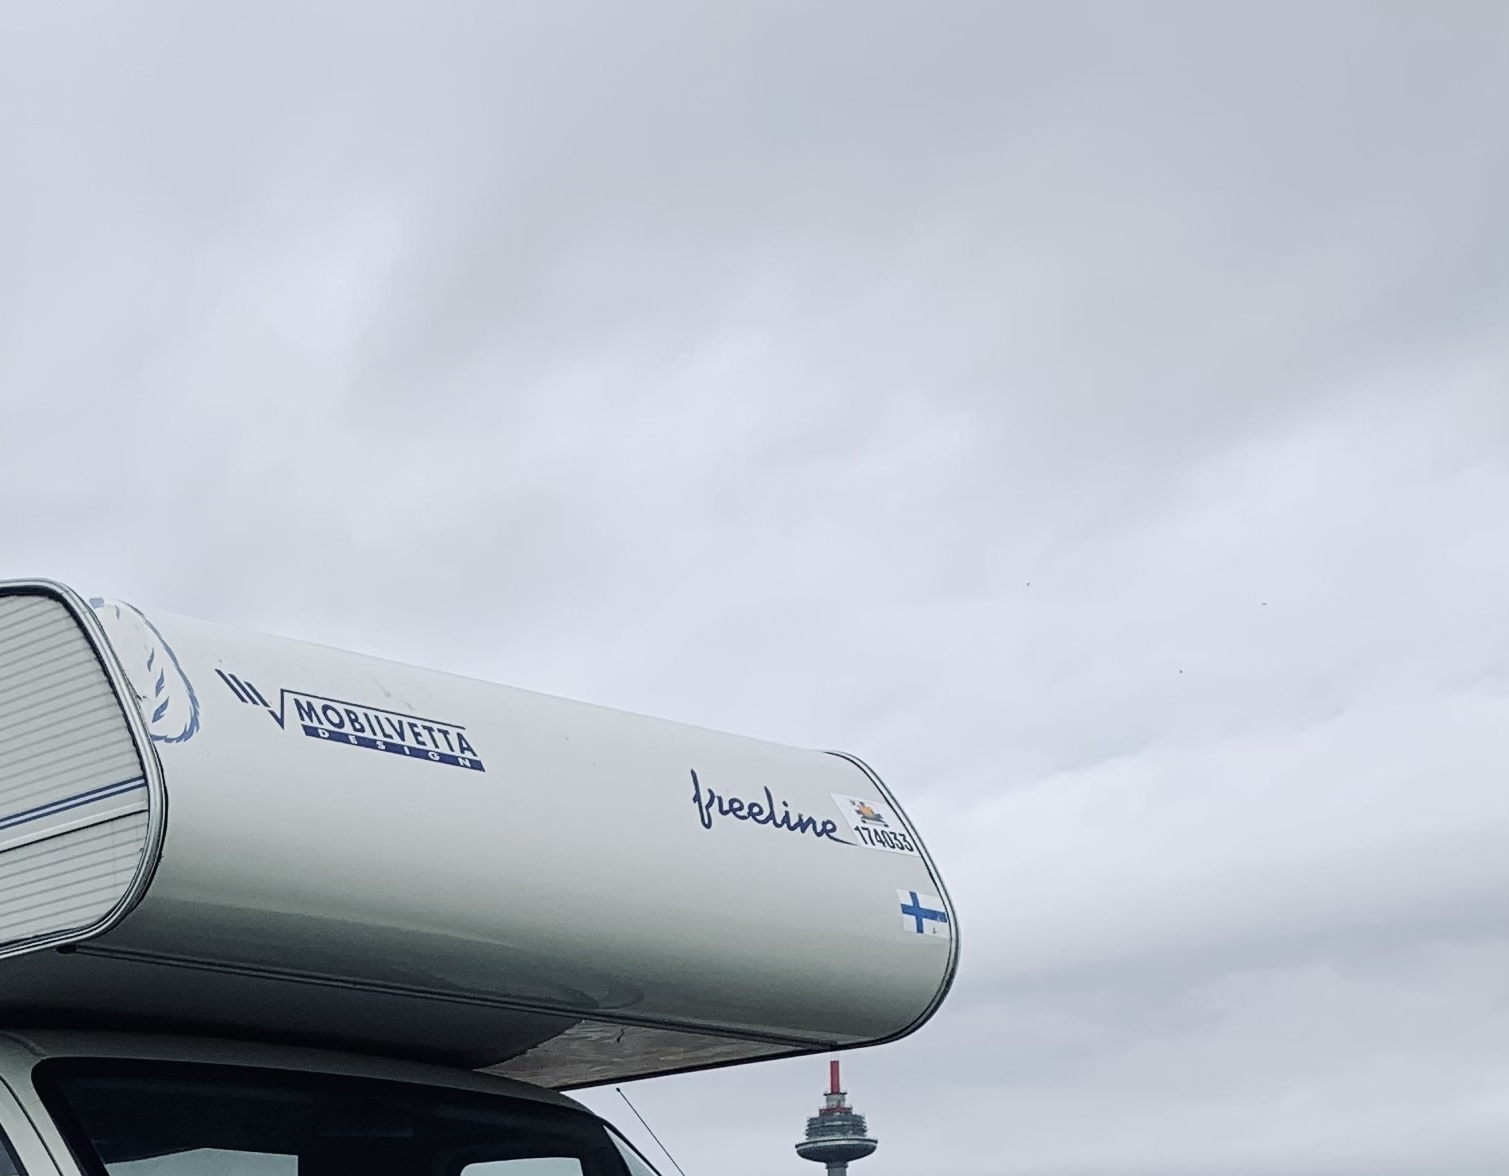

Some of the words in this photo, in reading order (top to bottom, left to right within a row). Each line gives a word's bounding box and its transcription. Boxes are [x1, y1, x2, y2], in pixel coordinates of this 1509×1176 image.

[293, 697, 479, 758] MOBILVETTA
[315, 726, 475, 769] DESIGN
[690, 768, 858, 846] freeline
[853, 824, 915, 853] 174033
